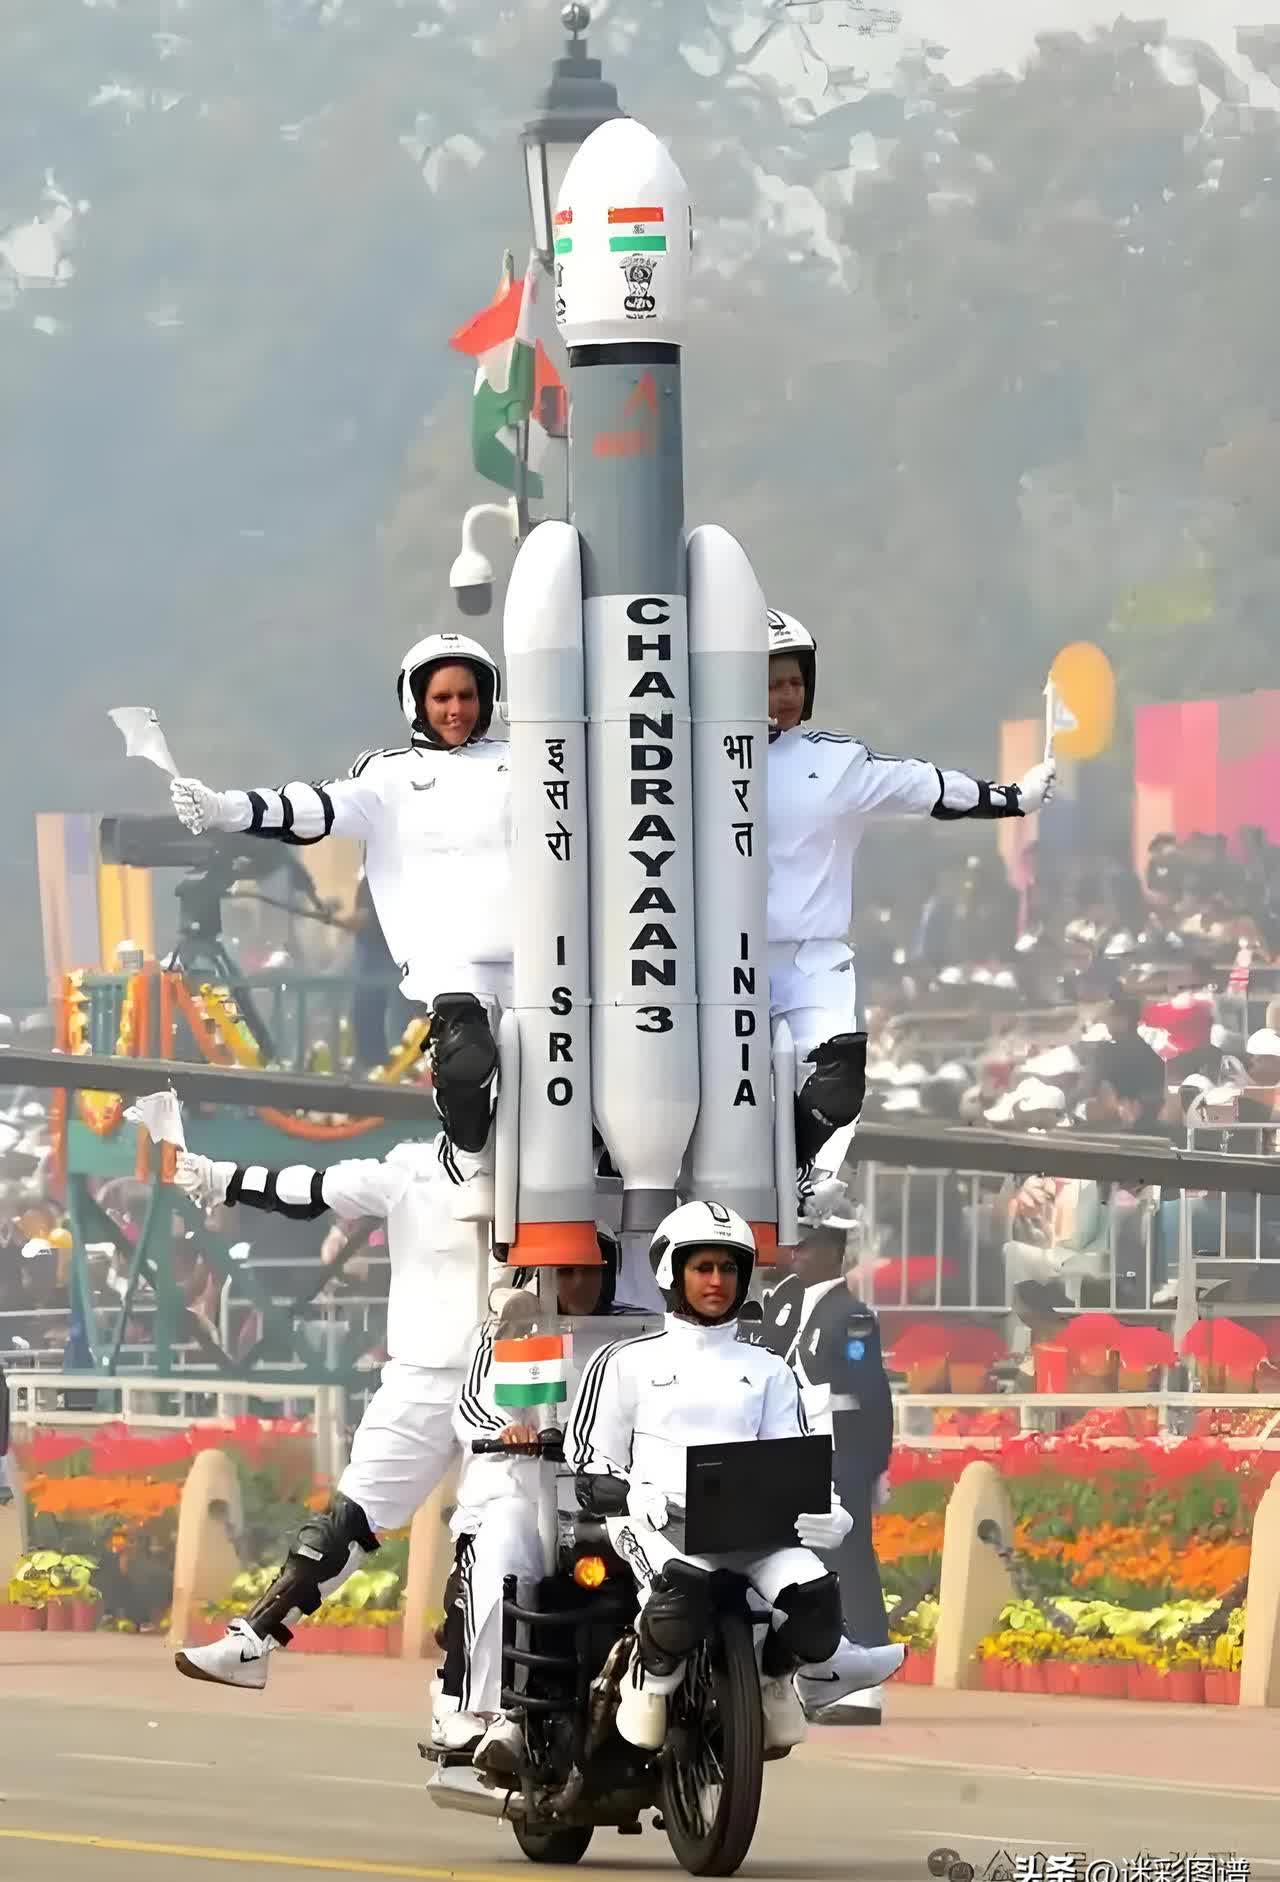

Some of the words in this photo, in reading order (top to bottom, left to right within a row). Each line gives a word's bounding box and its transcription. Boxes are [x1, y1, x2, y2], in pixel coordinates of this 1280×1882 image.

[543, 738, 573, 861] इसरो
[626, 597, 677, 986] CHANDRAYAAN
[723, 735, 754, 857] भारत
[547, 935, 574, 1106] ISRO
[635, 1006, 674, 1033] 3
[733, 932, 757, 1106] INDIA
